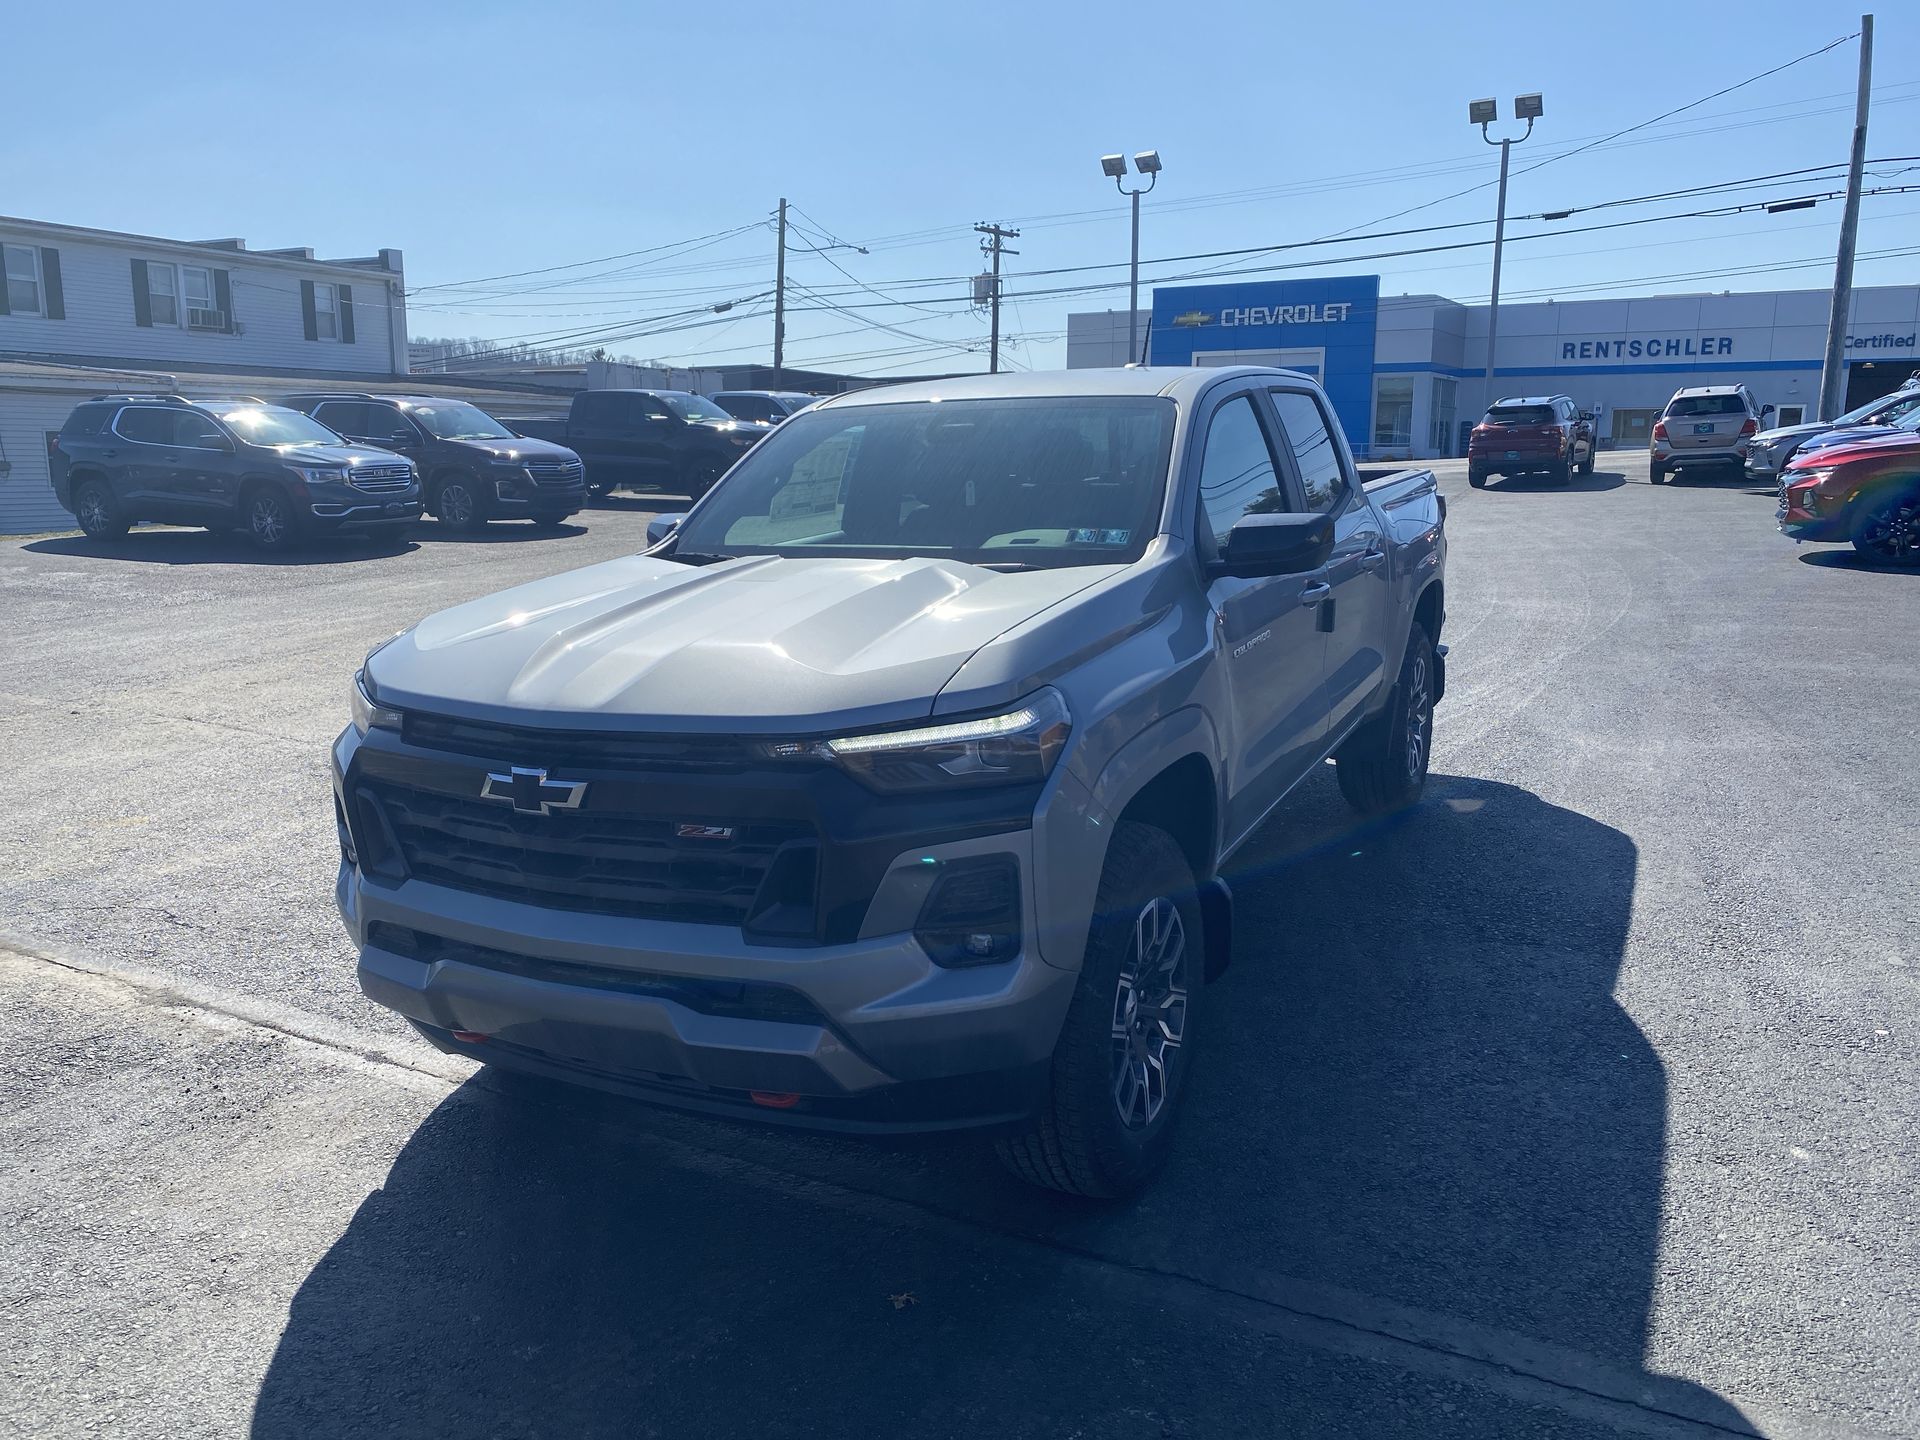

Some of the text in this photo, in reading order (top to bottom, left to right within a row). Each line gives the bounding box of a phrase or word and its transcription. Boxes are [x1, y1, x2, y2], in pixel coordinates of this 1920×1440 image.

[1221, 302, 1352, 327] CHEVROLET
[1562, 337, 1733, 359] RENTSCHLER
[1844, 333, 1916, 348] Certified
[1233, 629, 1271, 658] COLORADO
[677, 824, 733, 839] Z71
